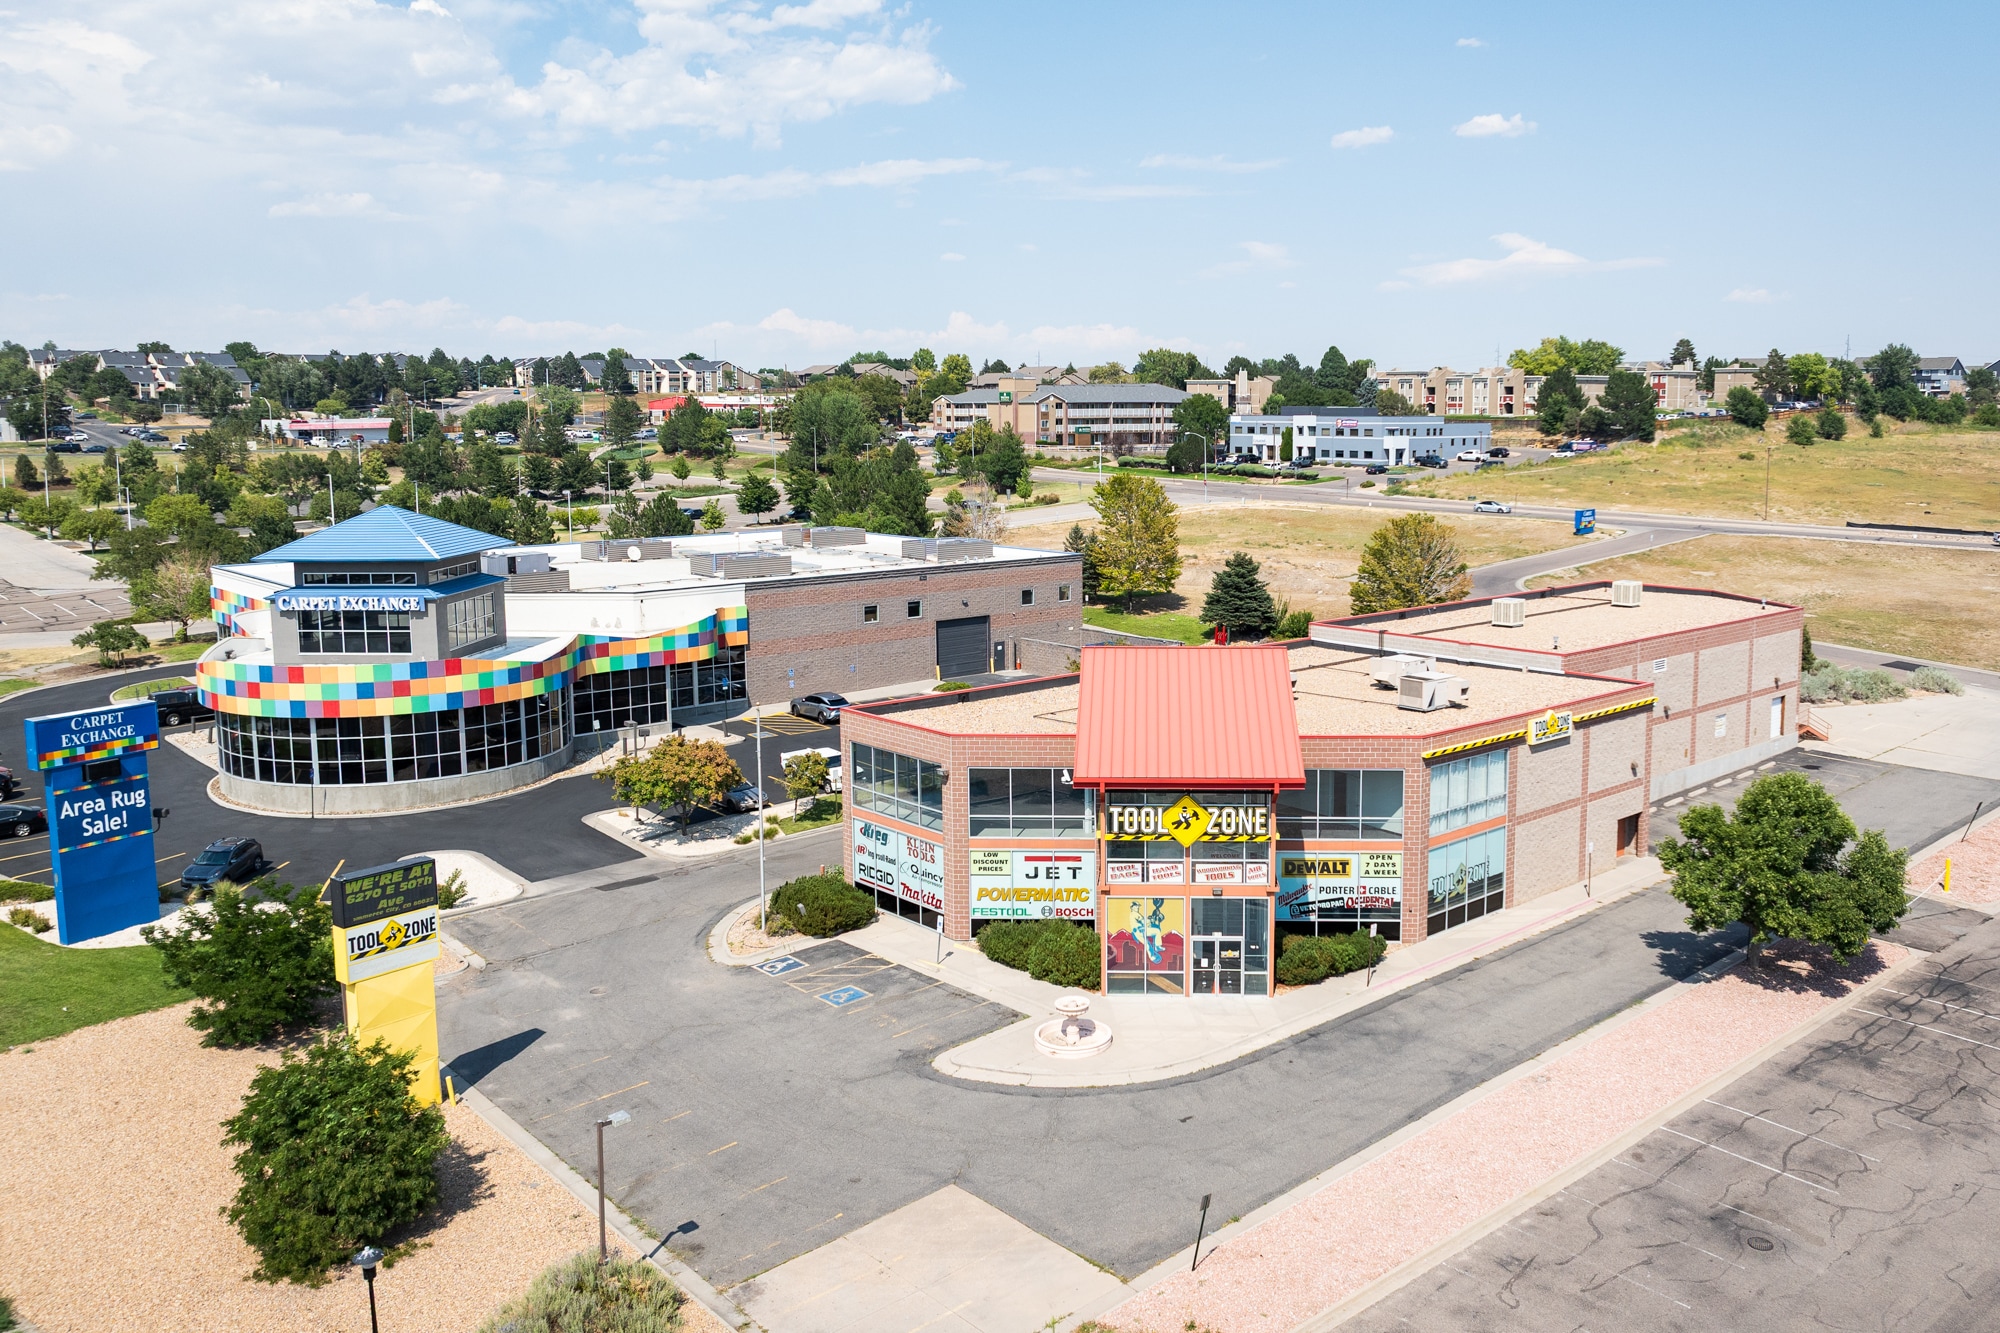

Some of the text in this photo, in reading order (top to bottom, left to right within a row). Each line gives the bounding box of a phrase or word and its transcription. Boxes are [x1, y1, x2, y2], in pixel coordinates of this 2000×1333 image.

[278, 595, 419, 611] CARPET EXCHANGE
[70, 711, 125, 731] CARPET
[1535, 714, 1570, 733] TOOL ZONE
[61, 724, 136, 748] EXCHANGE
[60, 789, 146, 820] Area Rug
[82, 810, 128, 837] Sale!
[1109, 806, 1269, 834] TOOL ZONE
[906, 836, 935, 855] KLEIN
[867, 849, 896, 866] Ingrsoll-Rand
[907, 846, 936, 864] TOOLS
[345, 863, 432, 894] WE'RE AT
[859, 862, 895, 886] RIDGID
[1025, 866, 1082, 880] JET
[1205, 871, 1235, 882] TOOLS
[346, 888, 382, 904] 6270
[386, 885, 395, 894] E
[976, 887, 1090, 903] POWERMATIC
[1319, 886, 1397, 894] PORTER CABLE
[377, 896, 404, 909] Ave
[1331, 899, 1344, 907] PAC
[972, 907, 1032, 917] FESTOOL
[1055, 907, 1094, 917] BOSCH
[348, 916, 436, 953] TOOL ZONE
